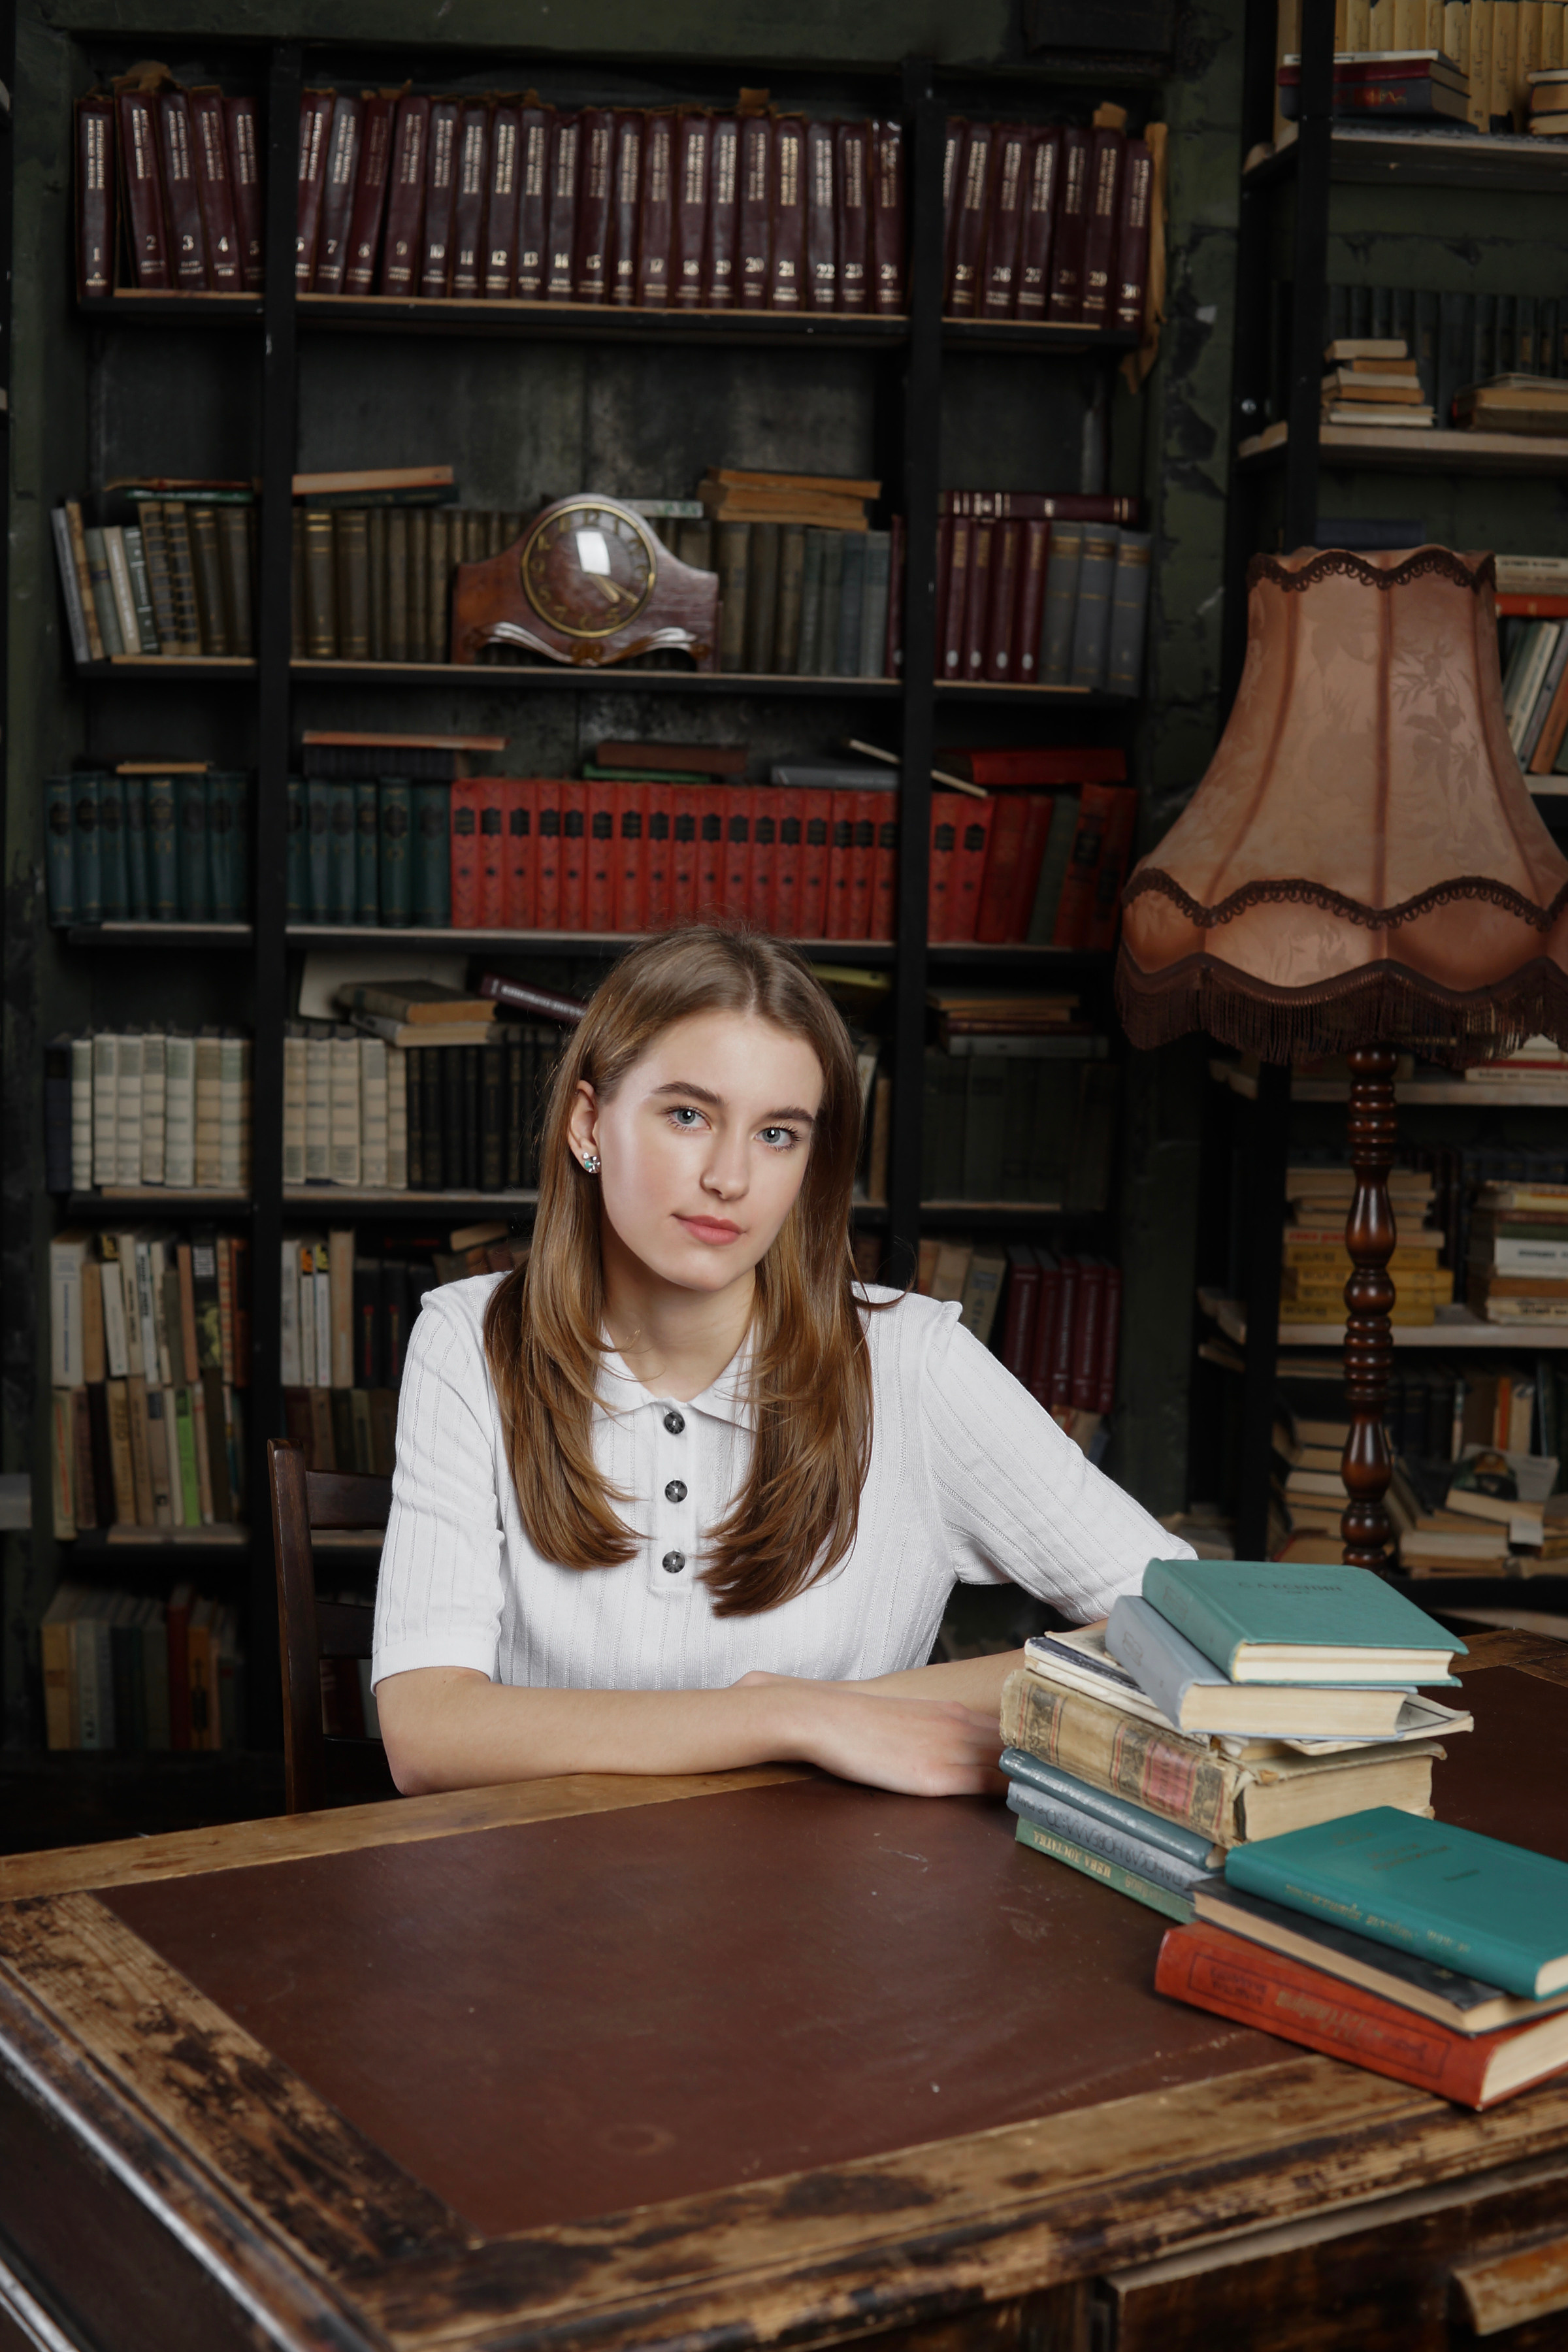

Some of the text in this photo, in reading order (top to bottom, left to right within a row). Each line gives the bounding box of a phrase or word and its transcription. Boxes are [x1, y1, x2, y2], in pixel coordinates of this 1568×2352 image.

[146, 235, 157, 251] 2
[182, 235, 194, 251] 3
[217, 236, 229, 252] 4
[249, 240, 260, 256] 5
[327, 239, 338, 254] 7
[358, 242, 370, 258] 8
[396, 240, 408, 256] 9
[429, 243, 446, 259] 10
[93, 247, 100, 262] 1
[460, 250, 474, 266] 11
[491, 250, 508, 267] 12
[523, 251, 539, 267] 13
[585, 253, 601, 270] 15
[617, 259, 633, 276] 16
[649, 258, 664, 274] 17
[683, 259, 700, 276] 18
[745, 256, 765, 273] 20
[778, 260, 795, 277] 21
[816, 263, 836, 279] 22
[845, 263, 864, 279] 23
[1024, 267, 1043, 284] 27
[1088, 270, 1108, 287] 29
[584, 509, 600, 527] 12
[604, 608, 621, 625] 5
[1032, 1829, 1083, 1862] ДОСТАТКА
